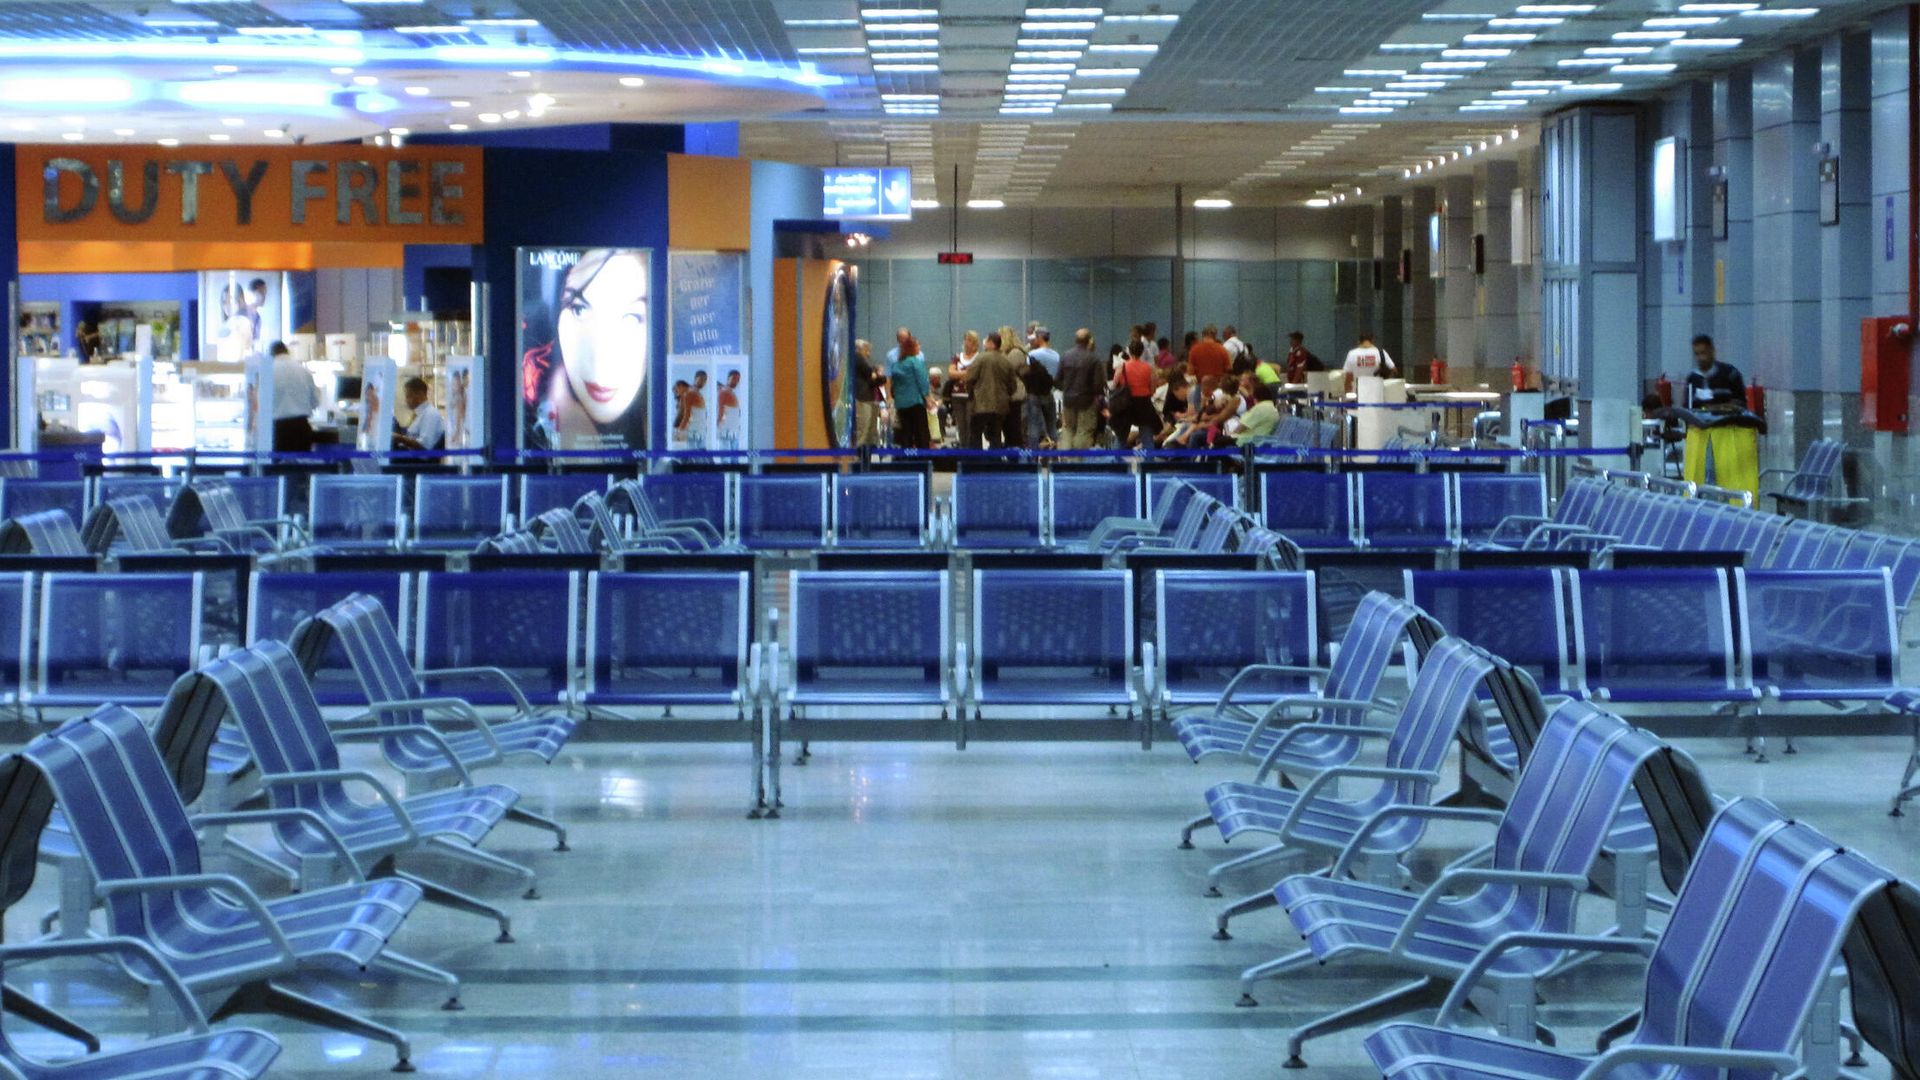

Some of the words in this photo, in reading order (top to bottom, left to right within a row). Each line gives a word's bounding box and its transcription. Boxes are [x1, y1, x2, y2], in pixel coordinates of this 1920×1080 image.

[43, 157, 269, 226] DUTY
[291, 159, 465, 226] FREE
[690, 312, 715, 326] aver
